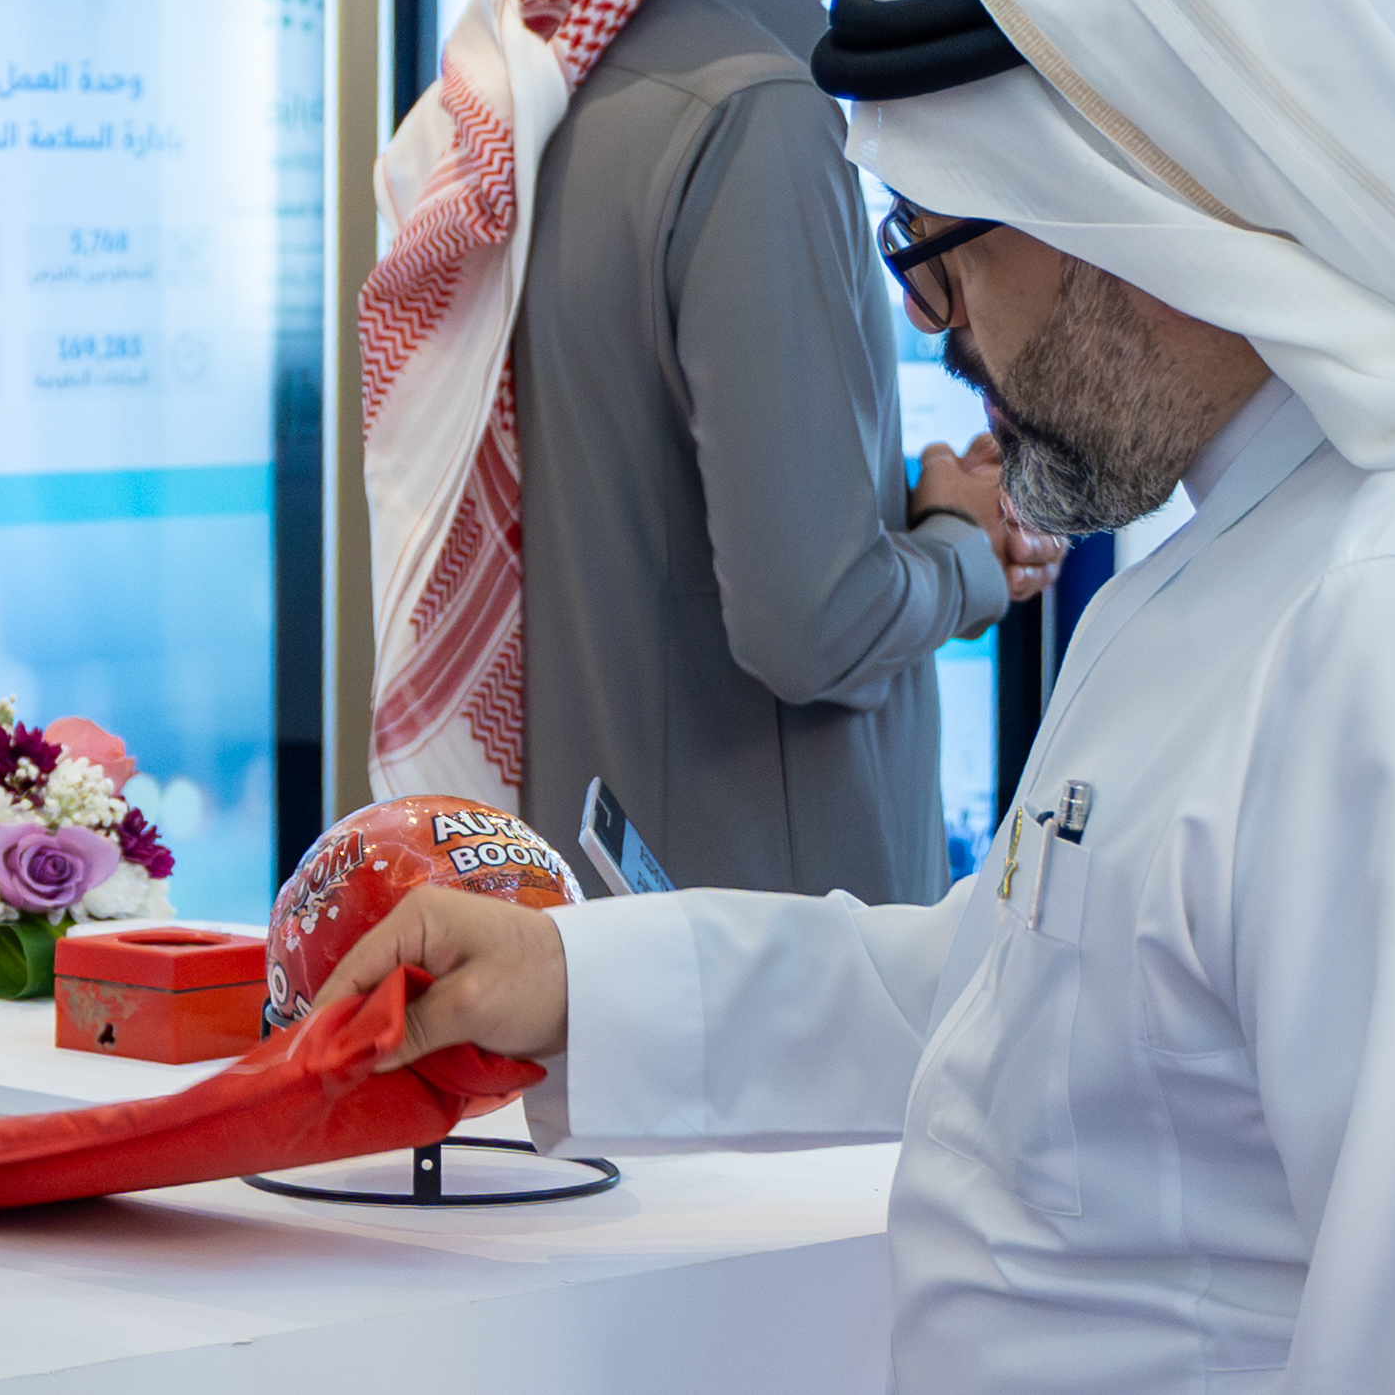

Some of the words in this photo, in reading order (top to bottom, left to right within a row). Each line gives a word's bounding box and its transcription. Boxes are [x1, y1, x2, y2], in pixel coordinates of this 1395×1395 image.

[78, 58, 144, 101] وحدة
[30, 118, 113, 149] السلامة
[432, 810, 538, 846] AUTO
[447, 841, 561, 875] BOOM
